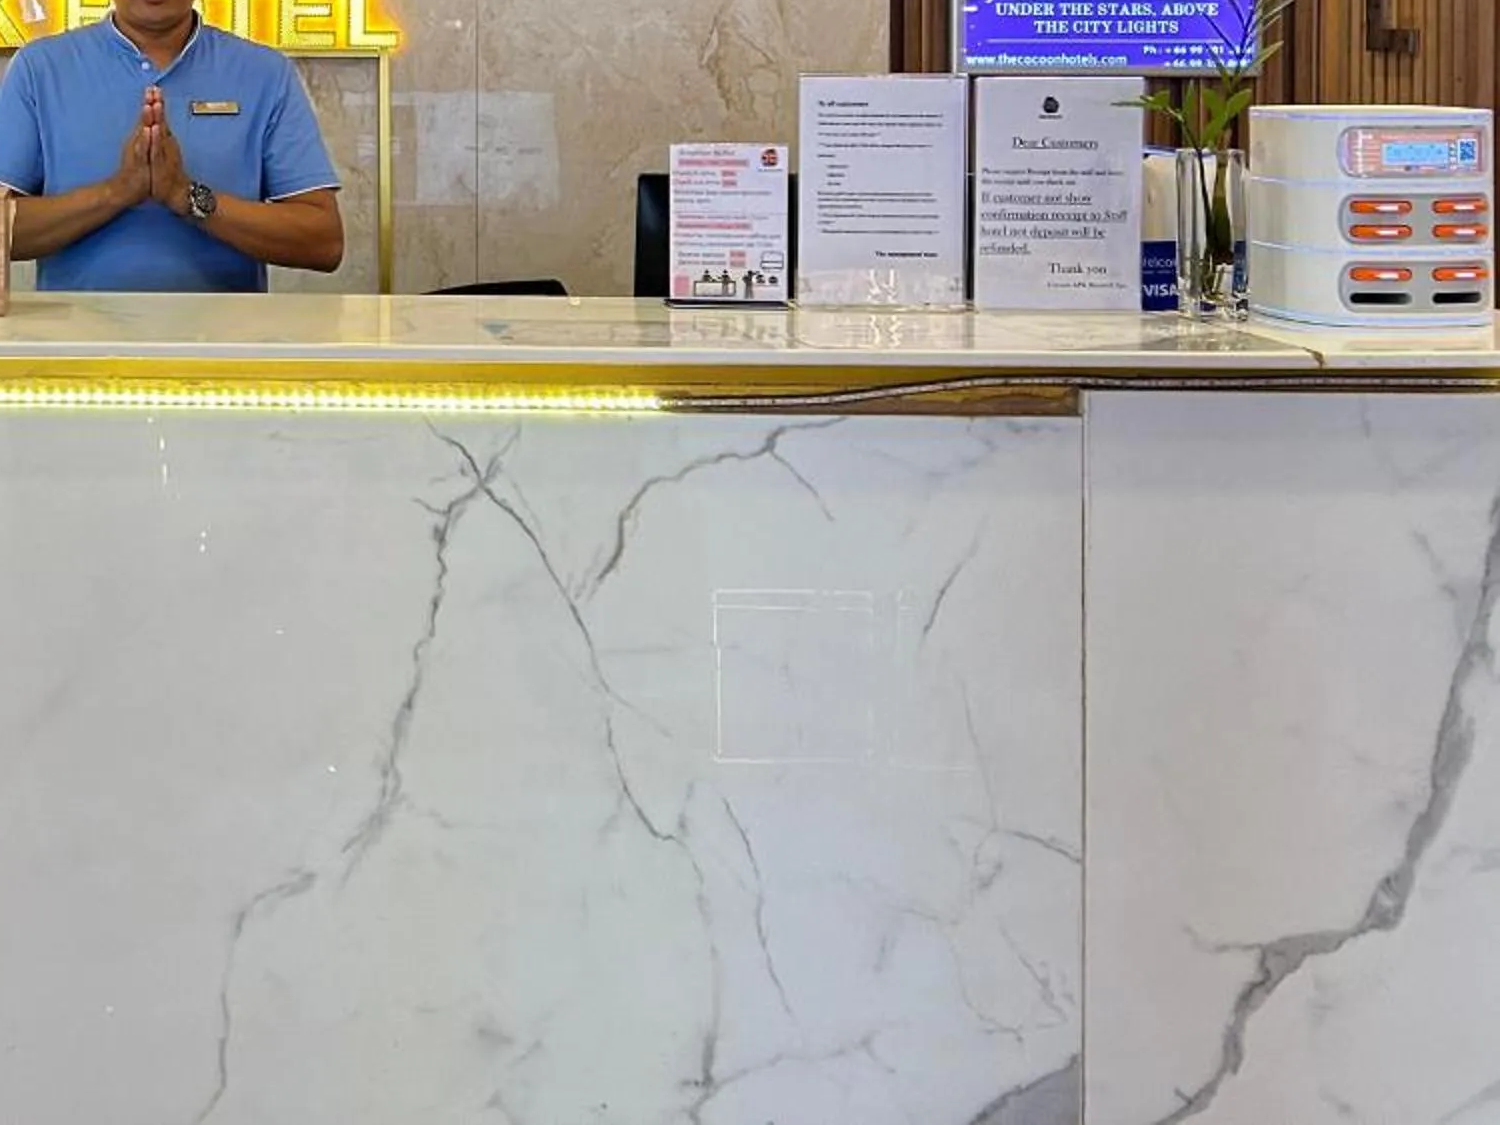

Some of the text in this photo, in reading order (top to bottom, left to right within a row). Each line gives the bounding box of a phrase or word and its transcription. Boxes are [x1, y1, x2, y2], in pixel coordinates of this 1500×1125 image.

[995, 3, 1057, 16] UNDER
[1060, 3, 1093, 16] THE
[1161, 3, 1220, 16] ABOVE
[1033, 20, 1180, 35] THE CITY LIGHTS
[964, 54, 1128, 68] www.thecocoonhotels.com
[1048, 262, 1084, 274] Thank
[1142, 283, 1180, 297] VISA
